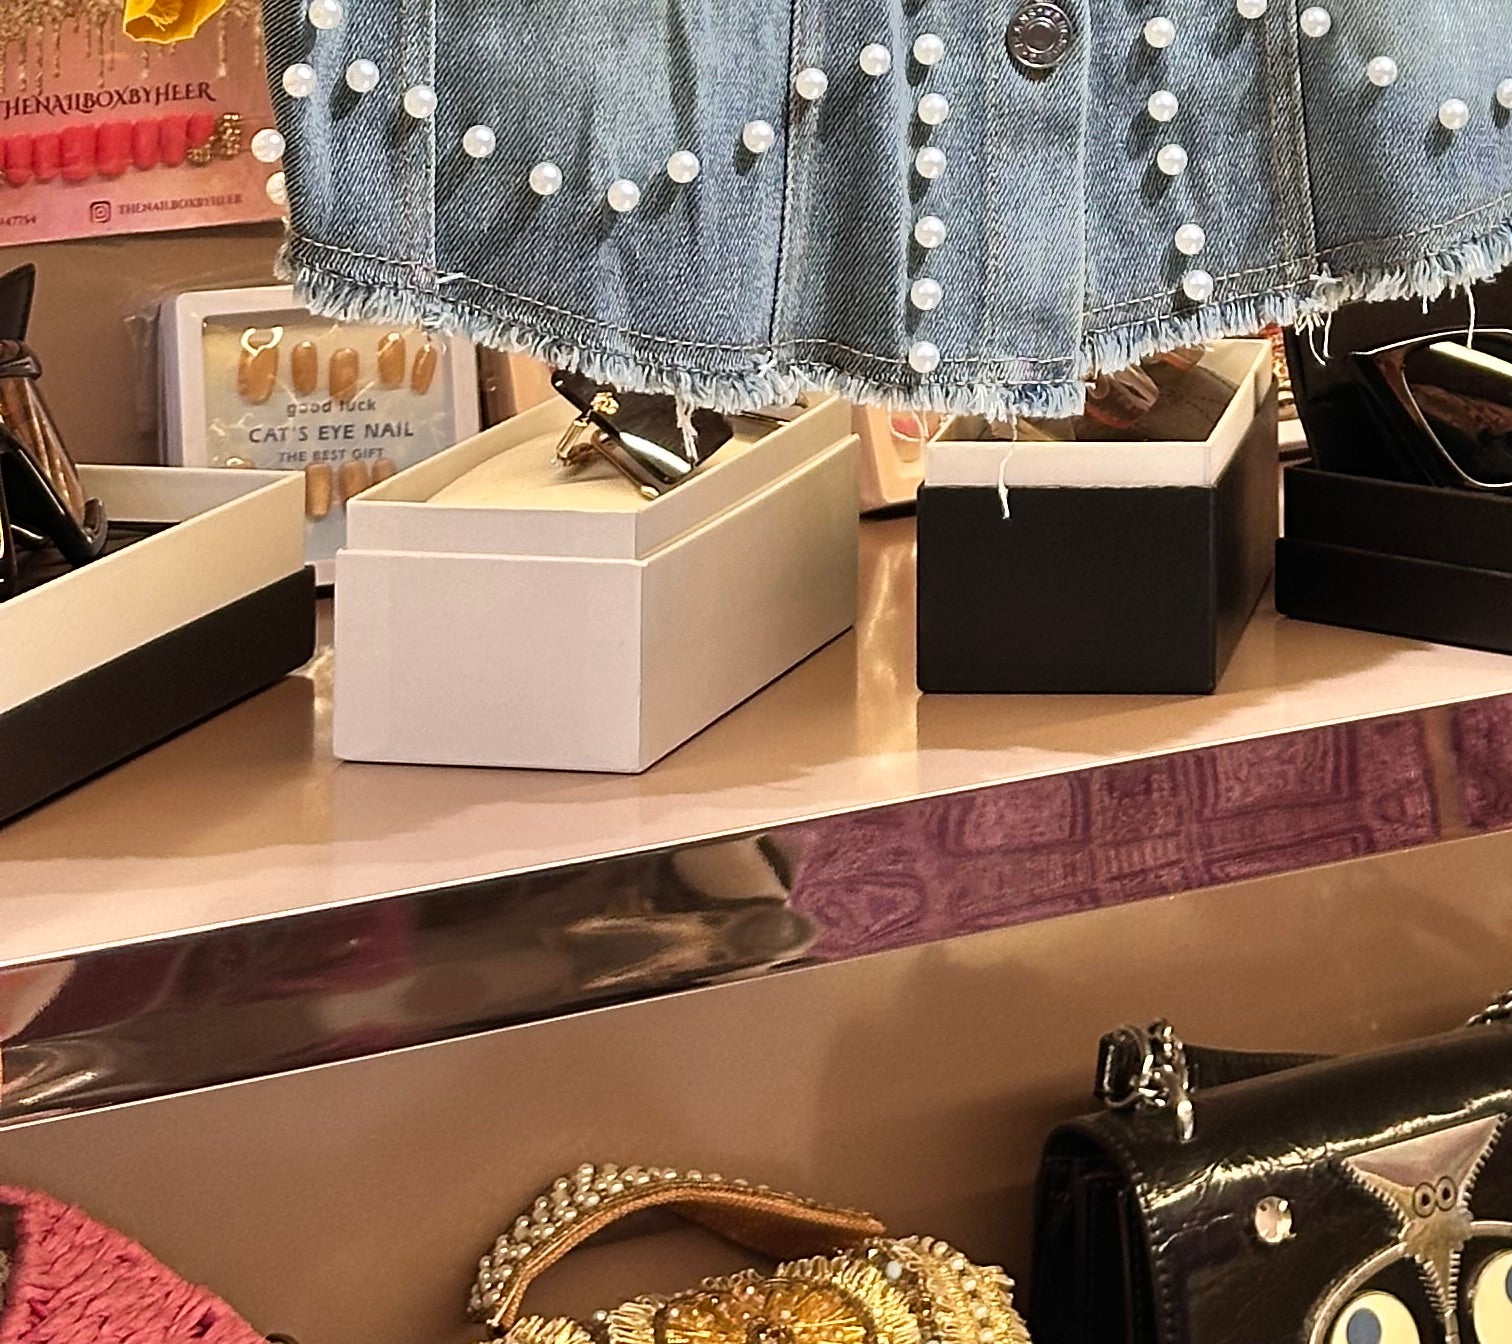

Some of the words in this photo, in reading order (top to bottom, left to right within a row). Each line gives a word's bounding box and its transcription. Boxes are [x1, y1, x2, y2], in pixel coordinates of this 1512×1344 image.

[286, 399, 332, 417] good
[248, 425, 308, 443] CAT'S
[318, 424, 355, 440] EYE
[364, 422, 414, 438] NAIL
[279, 450, 308, 462] THE
[312, 449, 346, 461] BEST
[352, 447, 385, 459] GIFT
